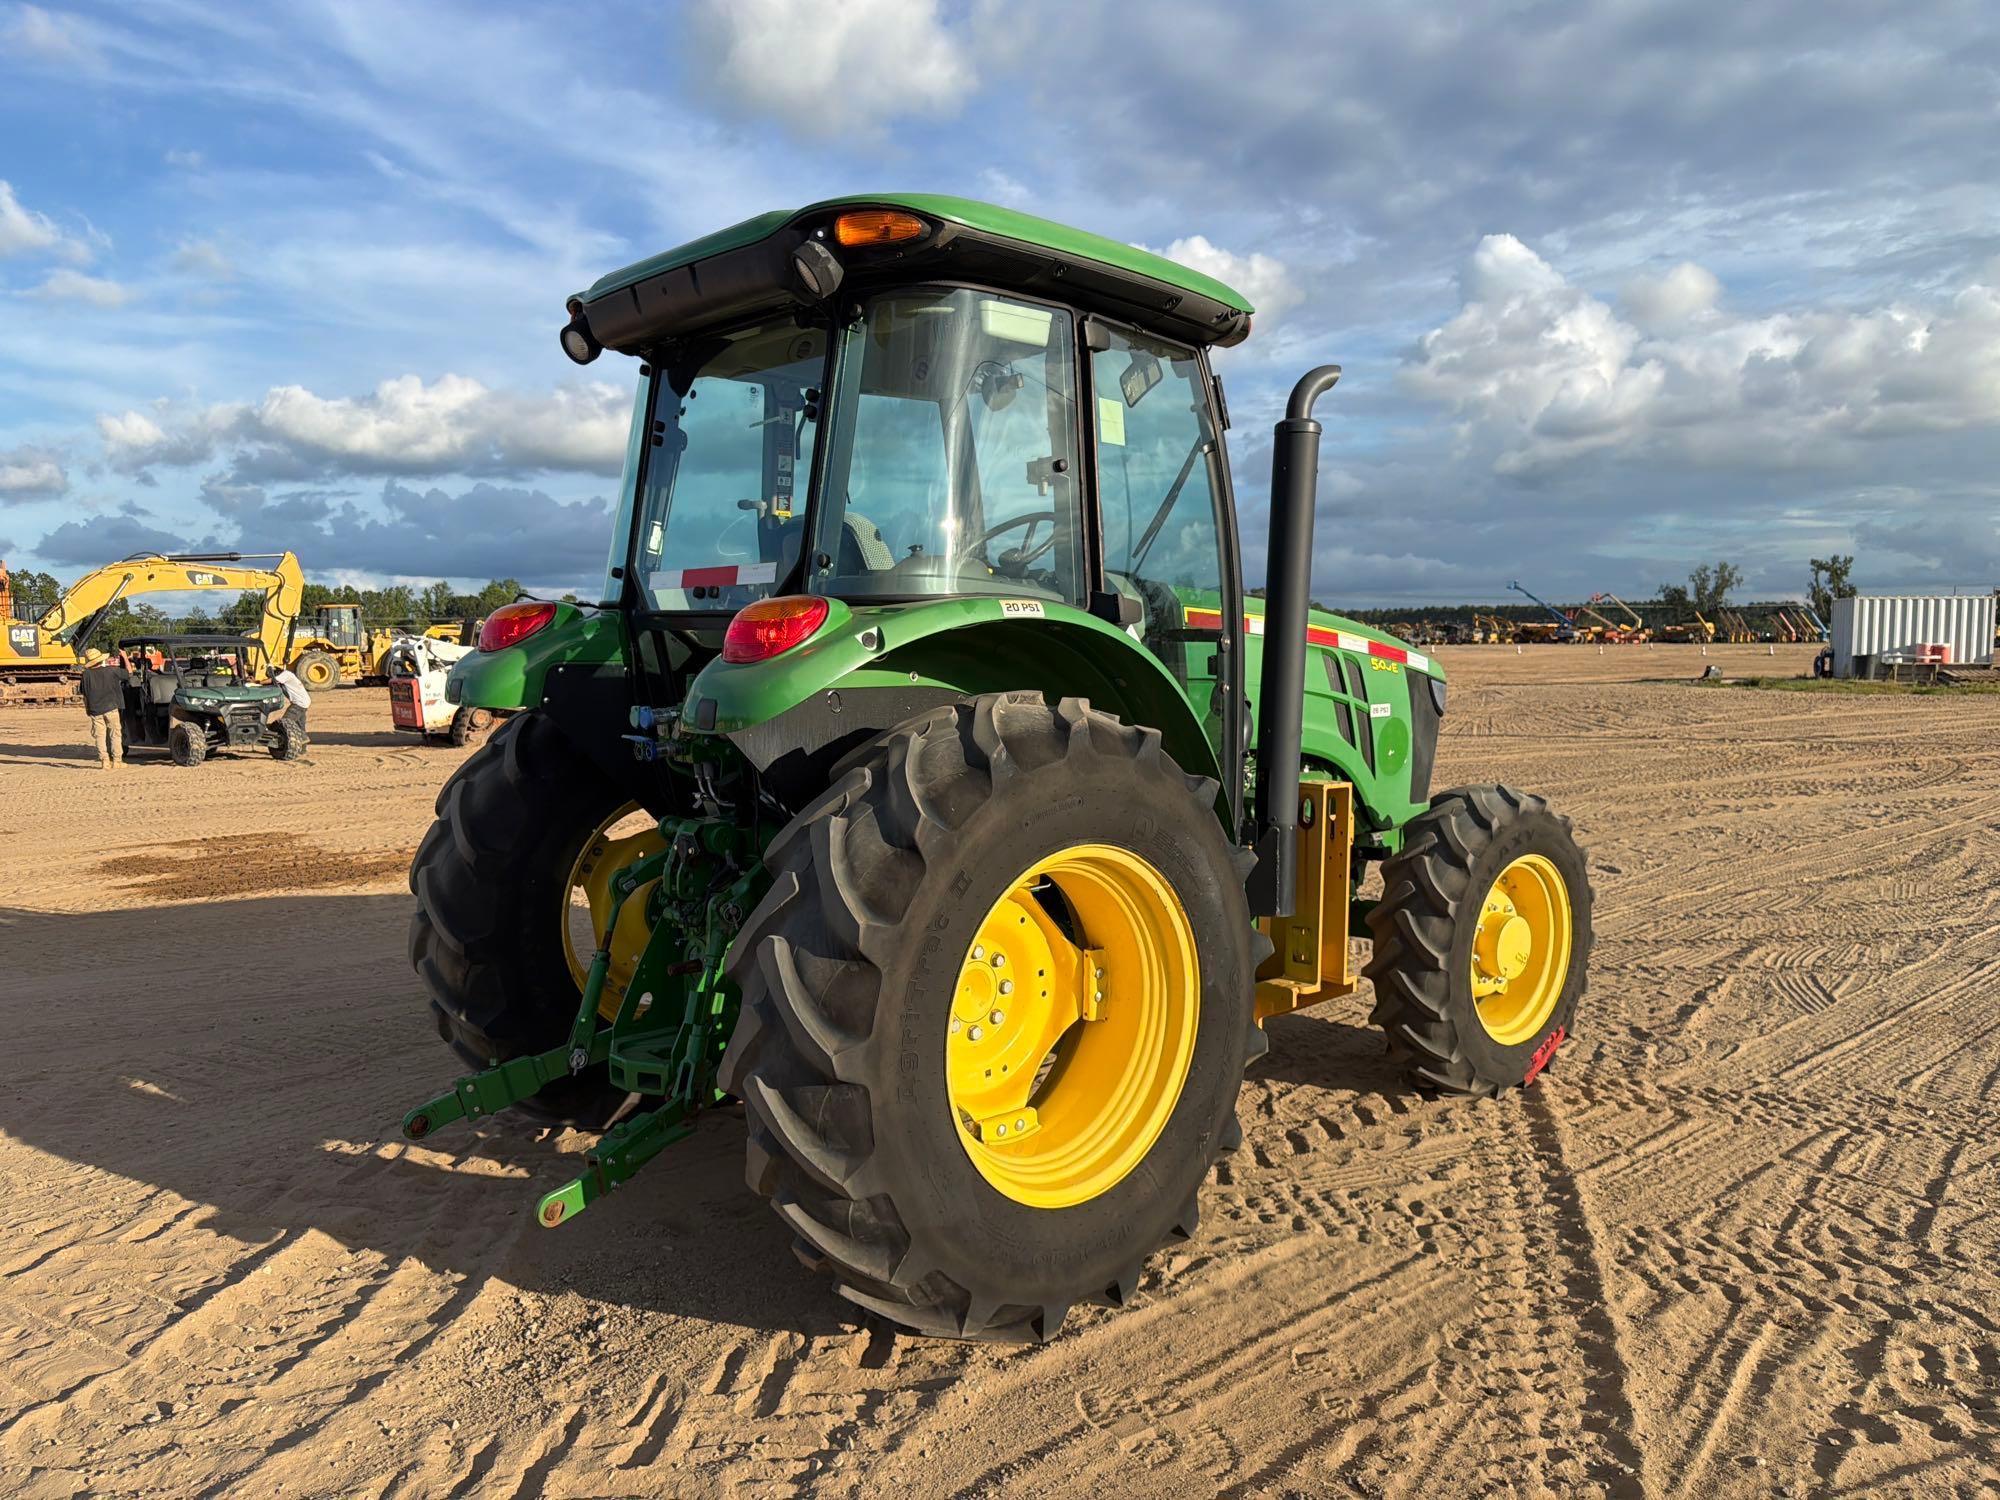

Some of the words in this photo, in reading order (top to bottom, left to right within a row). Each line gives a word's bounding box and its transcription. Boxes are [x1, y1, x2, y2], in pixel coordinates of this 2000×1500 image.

[195, 574, 213, 585] CAT
[1005, 602, 1020, 612] 20
[1022, 603, 1041, 613] PSI
[11, 629, 35, 642] CAT
